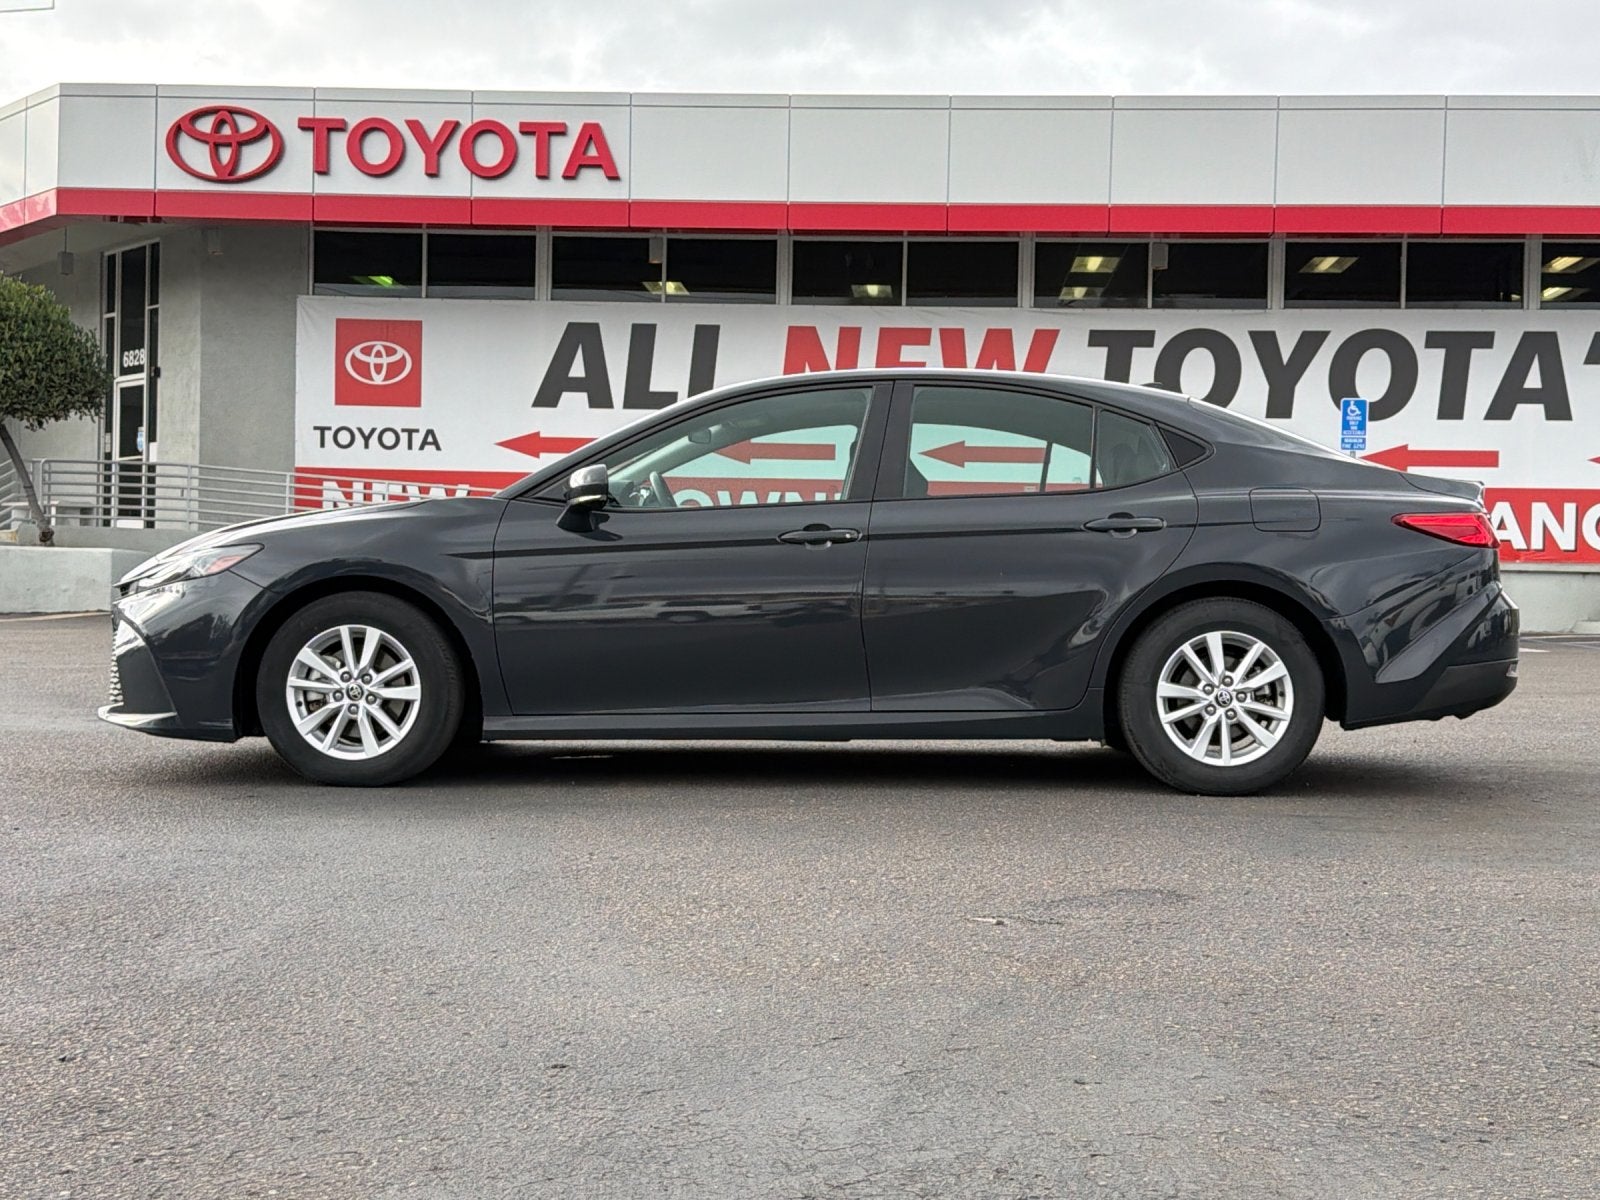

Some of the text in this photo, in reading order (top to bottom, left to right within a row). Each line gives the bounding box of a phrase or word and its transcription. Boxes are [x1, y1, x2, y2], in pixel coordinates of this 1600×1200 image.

[298, 117, 621, 181] TOYOTA
[123, 348, 145, 368] 6828
[313, 426, 442, 452] TOYOTA
